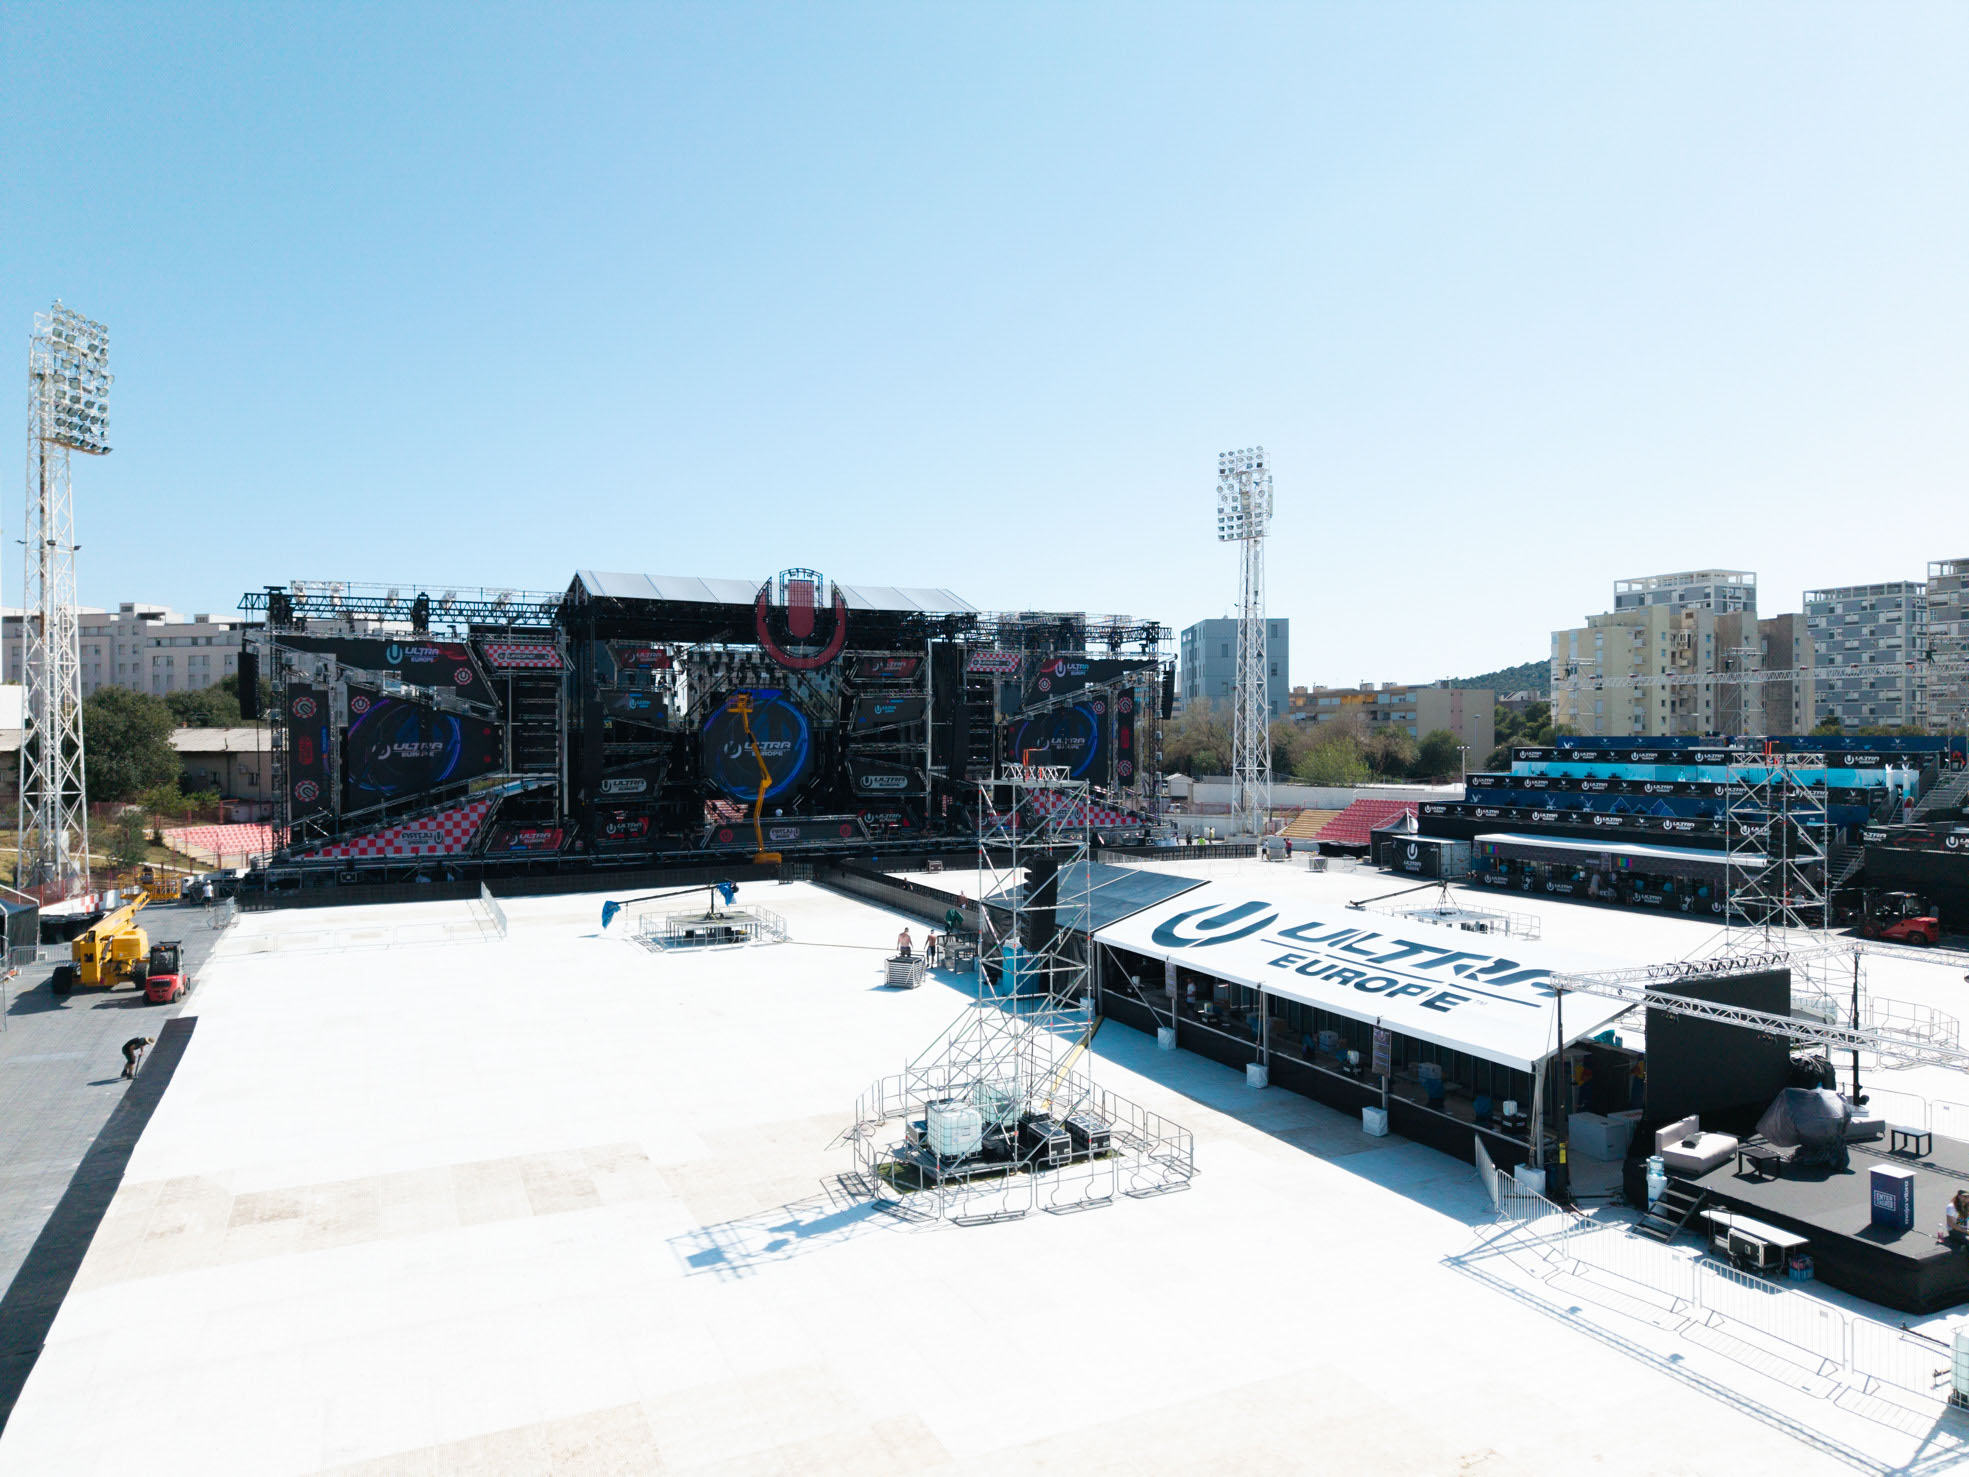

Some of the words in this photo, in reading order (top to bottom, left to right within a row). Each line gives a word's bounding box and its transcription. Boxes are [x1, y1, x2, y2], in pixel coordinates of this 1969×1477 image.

[404, 646, 439, 656] ULTRA
[1268, 952, 1472, 1012] EUROPE
[1277, 921, 1567, 996] ULTRA
